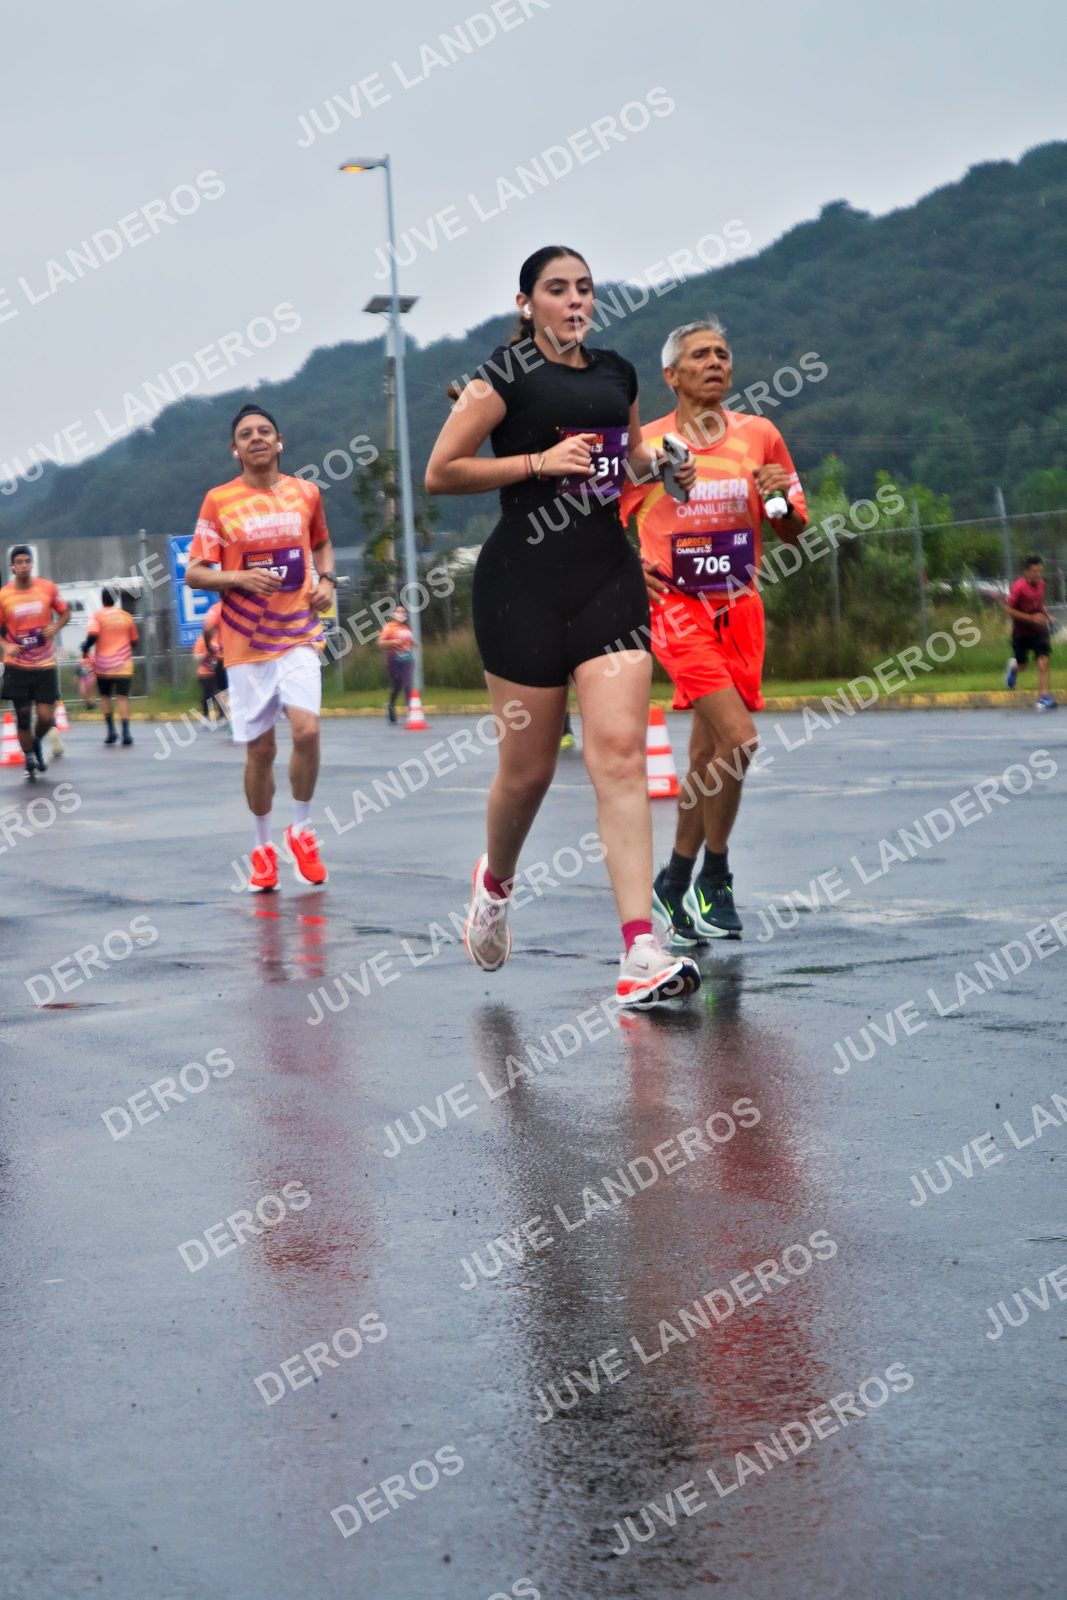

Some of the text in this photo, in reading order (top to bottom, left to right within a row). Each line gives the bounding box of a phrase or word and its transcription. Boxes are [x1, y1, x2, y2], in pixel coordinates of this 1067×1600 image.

[592, 456, 619, 476] 31
[674, 479, 748, 501] ARRERA
[676, 501, 733, 518] OMNILIFE
[733, 533, 748, 545] 15K
[267, 565, 288, 579] 57
[693, 555, 731, 575] 706
[183, 584, 210, 622] E
